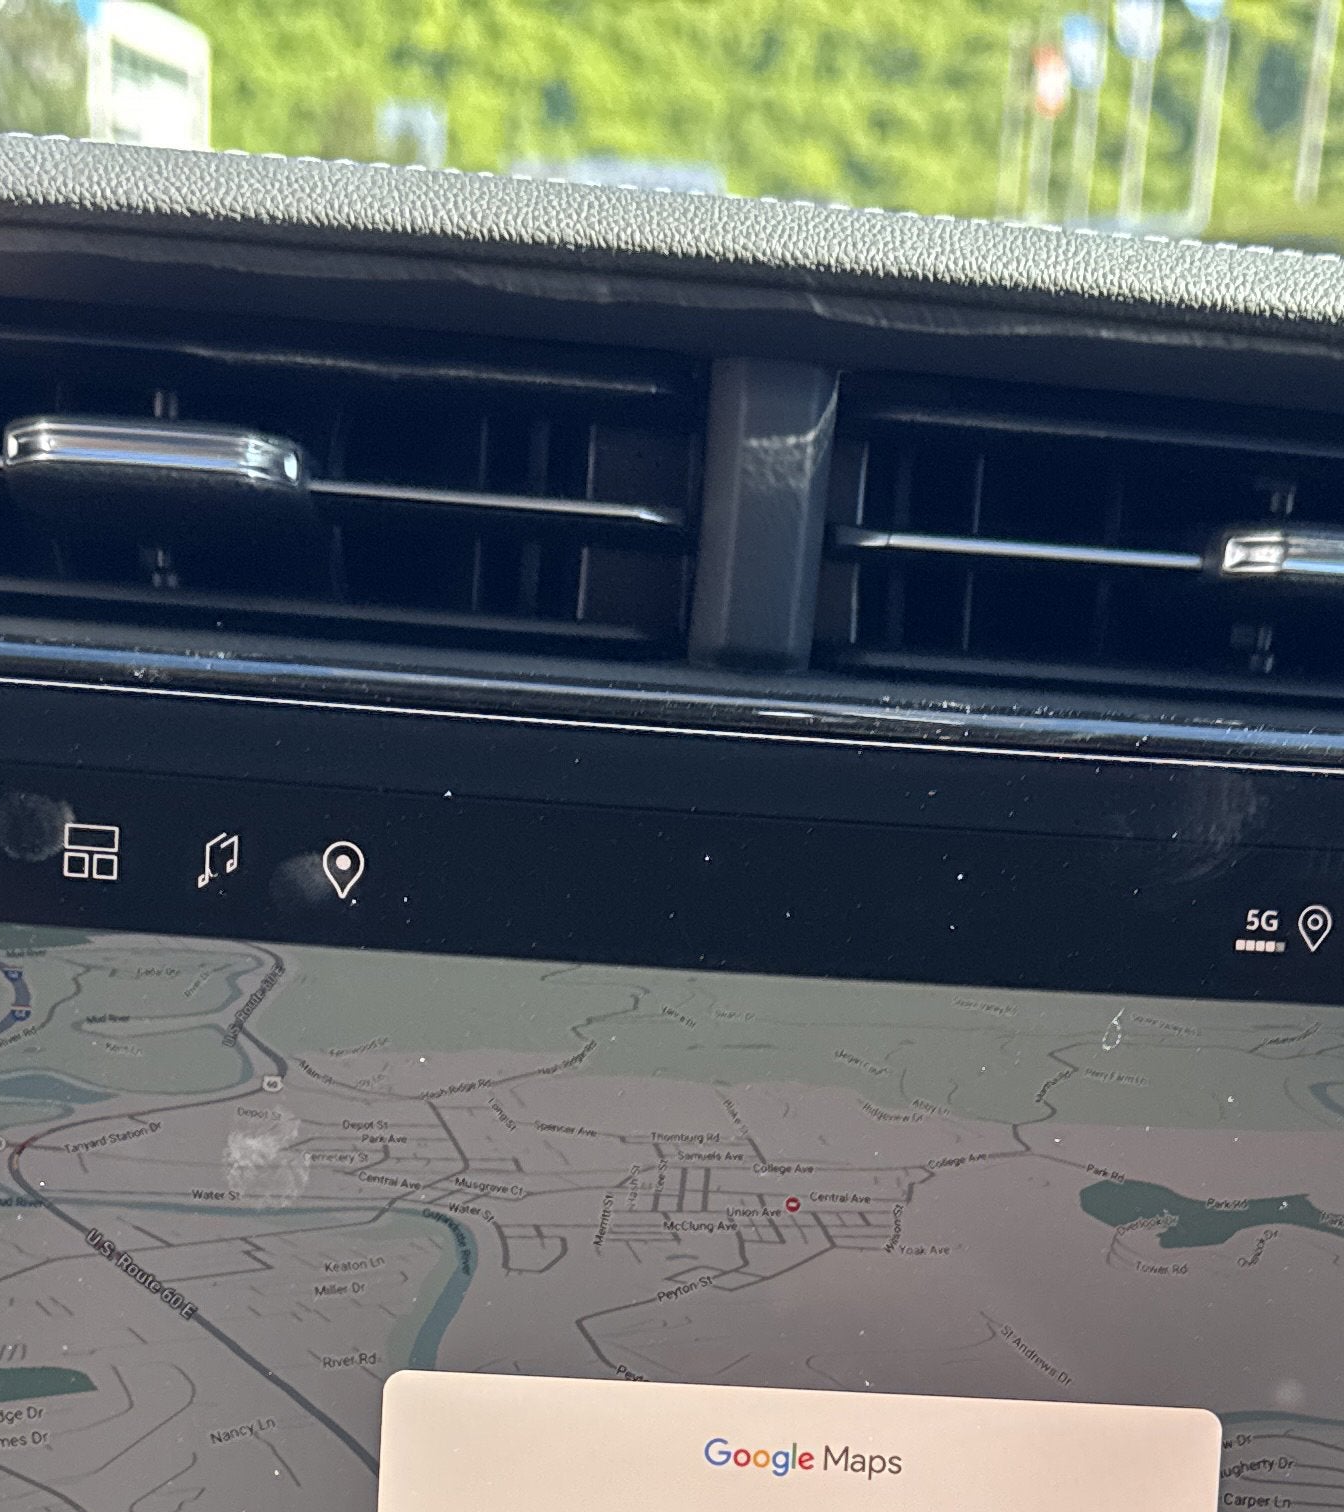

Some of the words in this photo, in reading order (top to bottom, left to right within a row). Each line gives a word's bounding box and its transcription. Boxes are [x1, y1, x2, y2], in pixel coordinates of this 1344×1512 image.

[1245, 909, 1279, 932] 5G
[343, 1119, 371, 1131] Depot
[374, 1120, 388, 1129] St
[65, 1138, 108, 1154] Tanyard
[109, 1126, 143, 1144] Station
[145, 1121, 161, 1133] Dr
[385, 1134, 407, 1143] Ave
[724, 1151, 744, 1161] Ave
[967, 1152, 987, 1162] Ave
[753, 1164, 790, 1176] College
[793, 1164, 814, 1174] Ave
[1087, 1164, 1109, 1178] Park
[1111, 1172, 1124, 1182] Rd
[358, 1172, 397, 1186] Central
[398, 1179, 422, 1191] Ave
[456, 1178, 504, 1196] Musgrave
[192, 1189, 225, 1201] Water
[228, 1189, 240, 1201] St
[810, 1193, 848, 1203] Central
[850, 1194, 870, 1204] Ave
[449, 1202, 481, 1216] Water
[482, 1210, 494, 1222] St
[727, 1208, 756, 1218] Union
[759, 1208, 781, 1217] Ave
[664, 1222, 714, 1233] McClung
[716, 1222, 737, 1231] Ave
[325, 1259, 364, 1274] Keaton
[86, 1228, 117, 1261] U.S.
[116, 1252, 161, 1294] Route
[161, 1286, 183, 1309] 60
[181, 1301, 197, 1321] E
[314, 1282, 345, 1295] Miller
[348, 1281, 365, 1294] Dr
[657, 1280, 698, 1302] Peyton
[695, 1276, 712, 1290] St
[322, 1354, 354, 1368] River
[357, 1351, 376, 1365] Rd
[1000, 1325, 1015, 1341] St
[1012, 1337, 1058, 1377] Andrews
[1057, 1371, 1072, 1385] Dr
[27, 1406, 44, 1421] Dr
[210, 1424, 251, 1445] Nancy
[255, 1416, 275, 1431] Ln
[28, 1431, 48, 1446] Dr
[704, 1439, 815, 1478] Google
[824, 1446, 902, 1476] Maps
[1278, 1457, 1292, 1469] Dr
[1224, 1493, 1270, 1508] Carper
[1275, 1496, 1290, 1508] Ln
